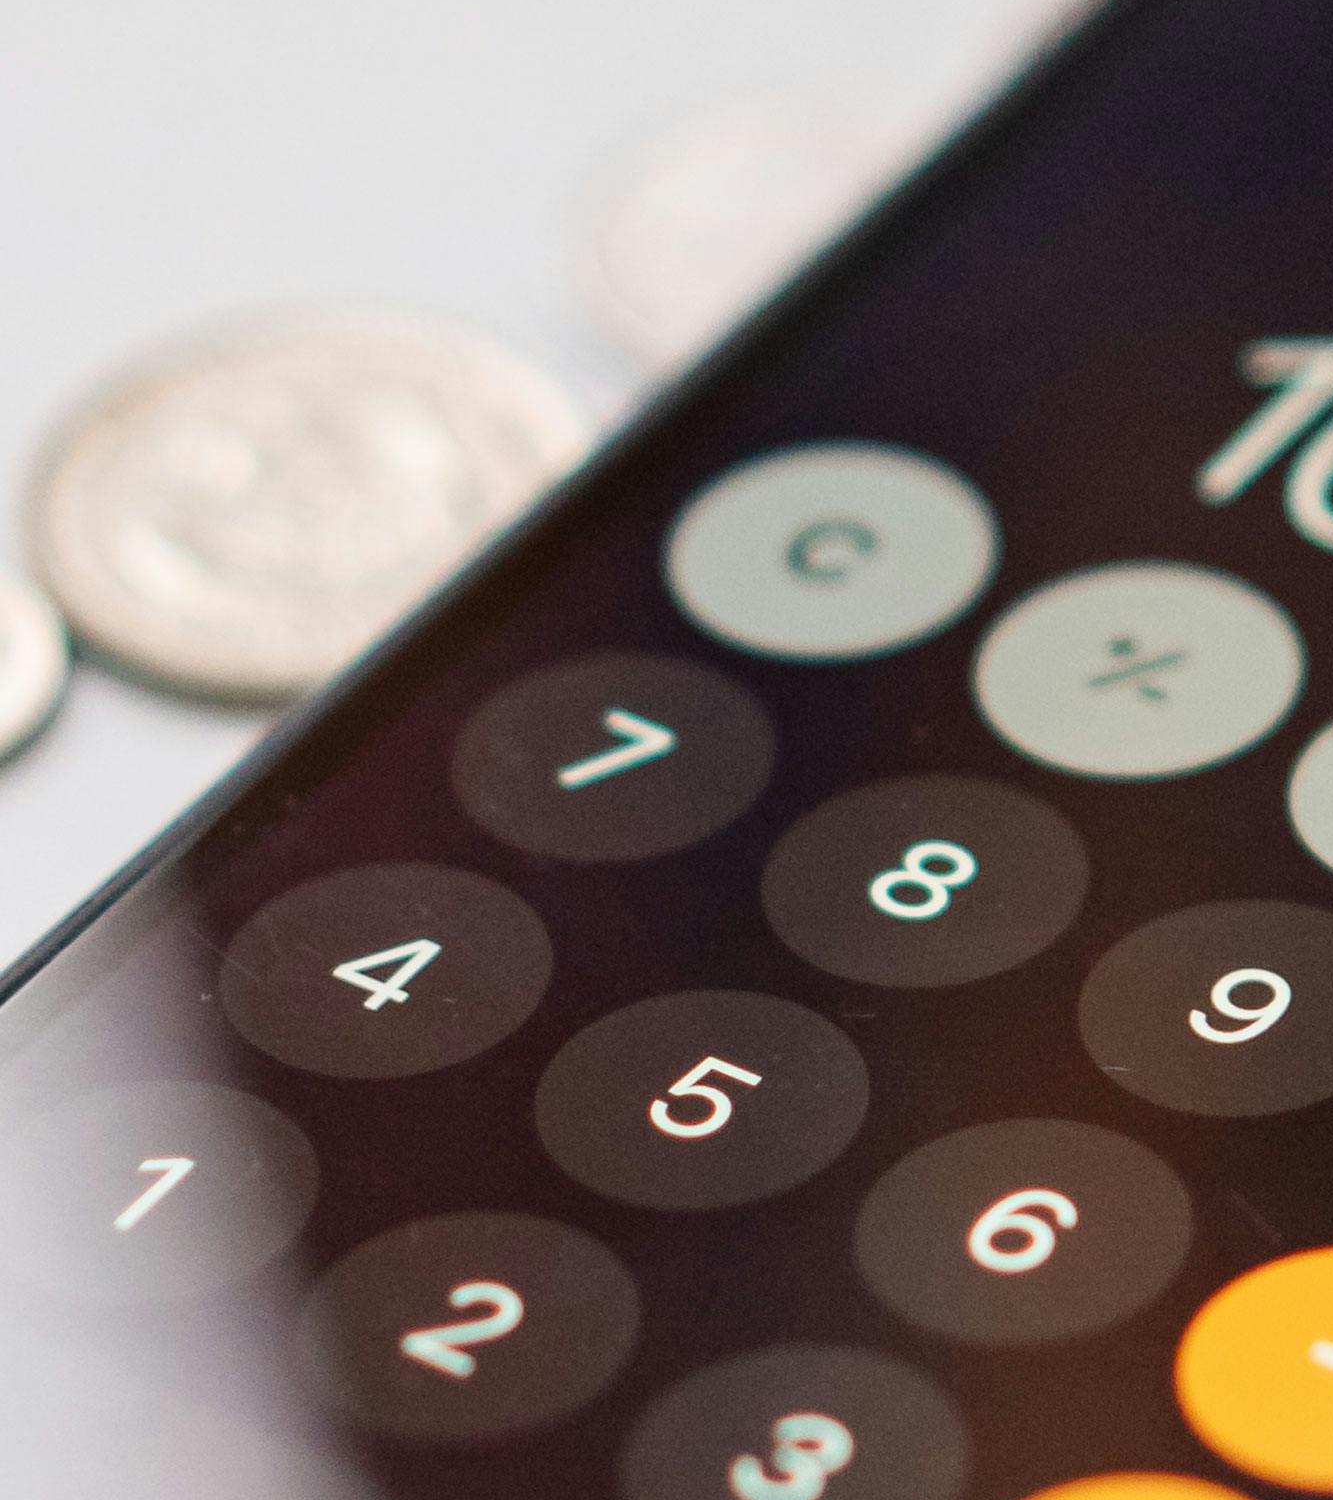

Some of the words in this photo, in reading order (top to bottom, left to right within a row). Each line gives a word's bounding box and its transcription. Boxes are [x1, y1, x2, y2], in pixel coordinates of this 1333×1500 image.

[557, 708, 676, 789] 7
[868, 838, 979, 920] 8
[333, 937, 442, 1011] 4
[1188, 967, 1292, 1044] 9
[650, 1056, 762, 1138] 5
[114, 1155, 194, 1232] 1
[966, 1187, 1079, 1274] 6
[402, 1280, 524, 1378] 2
